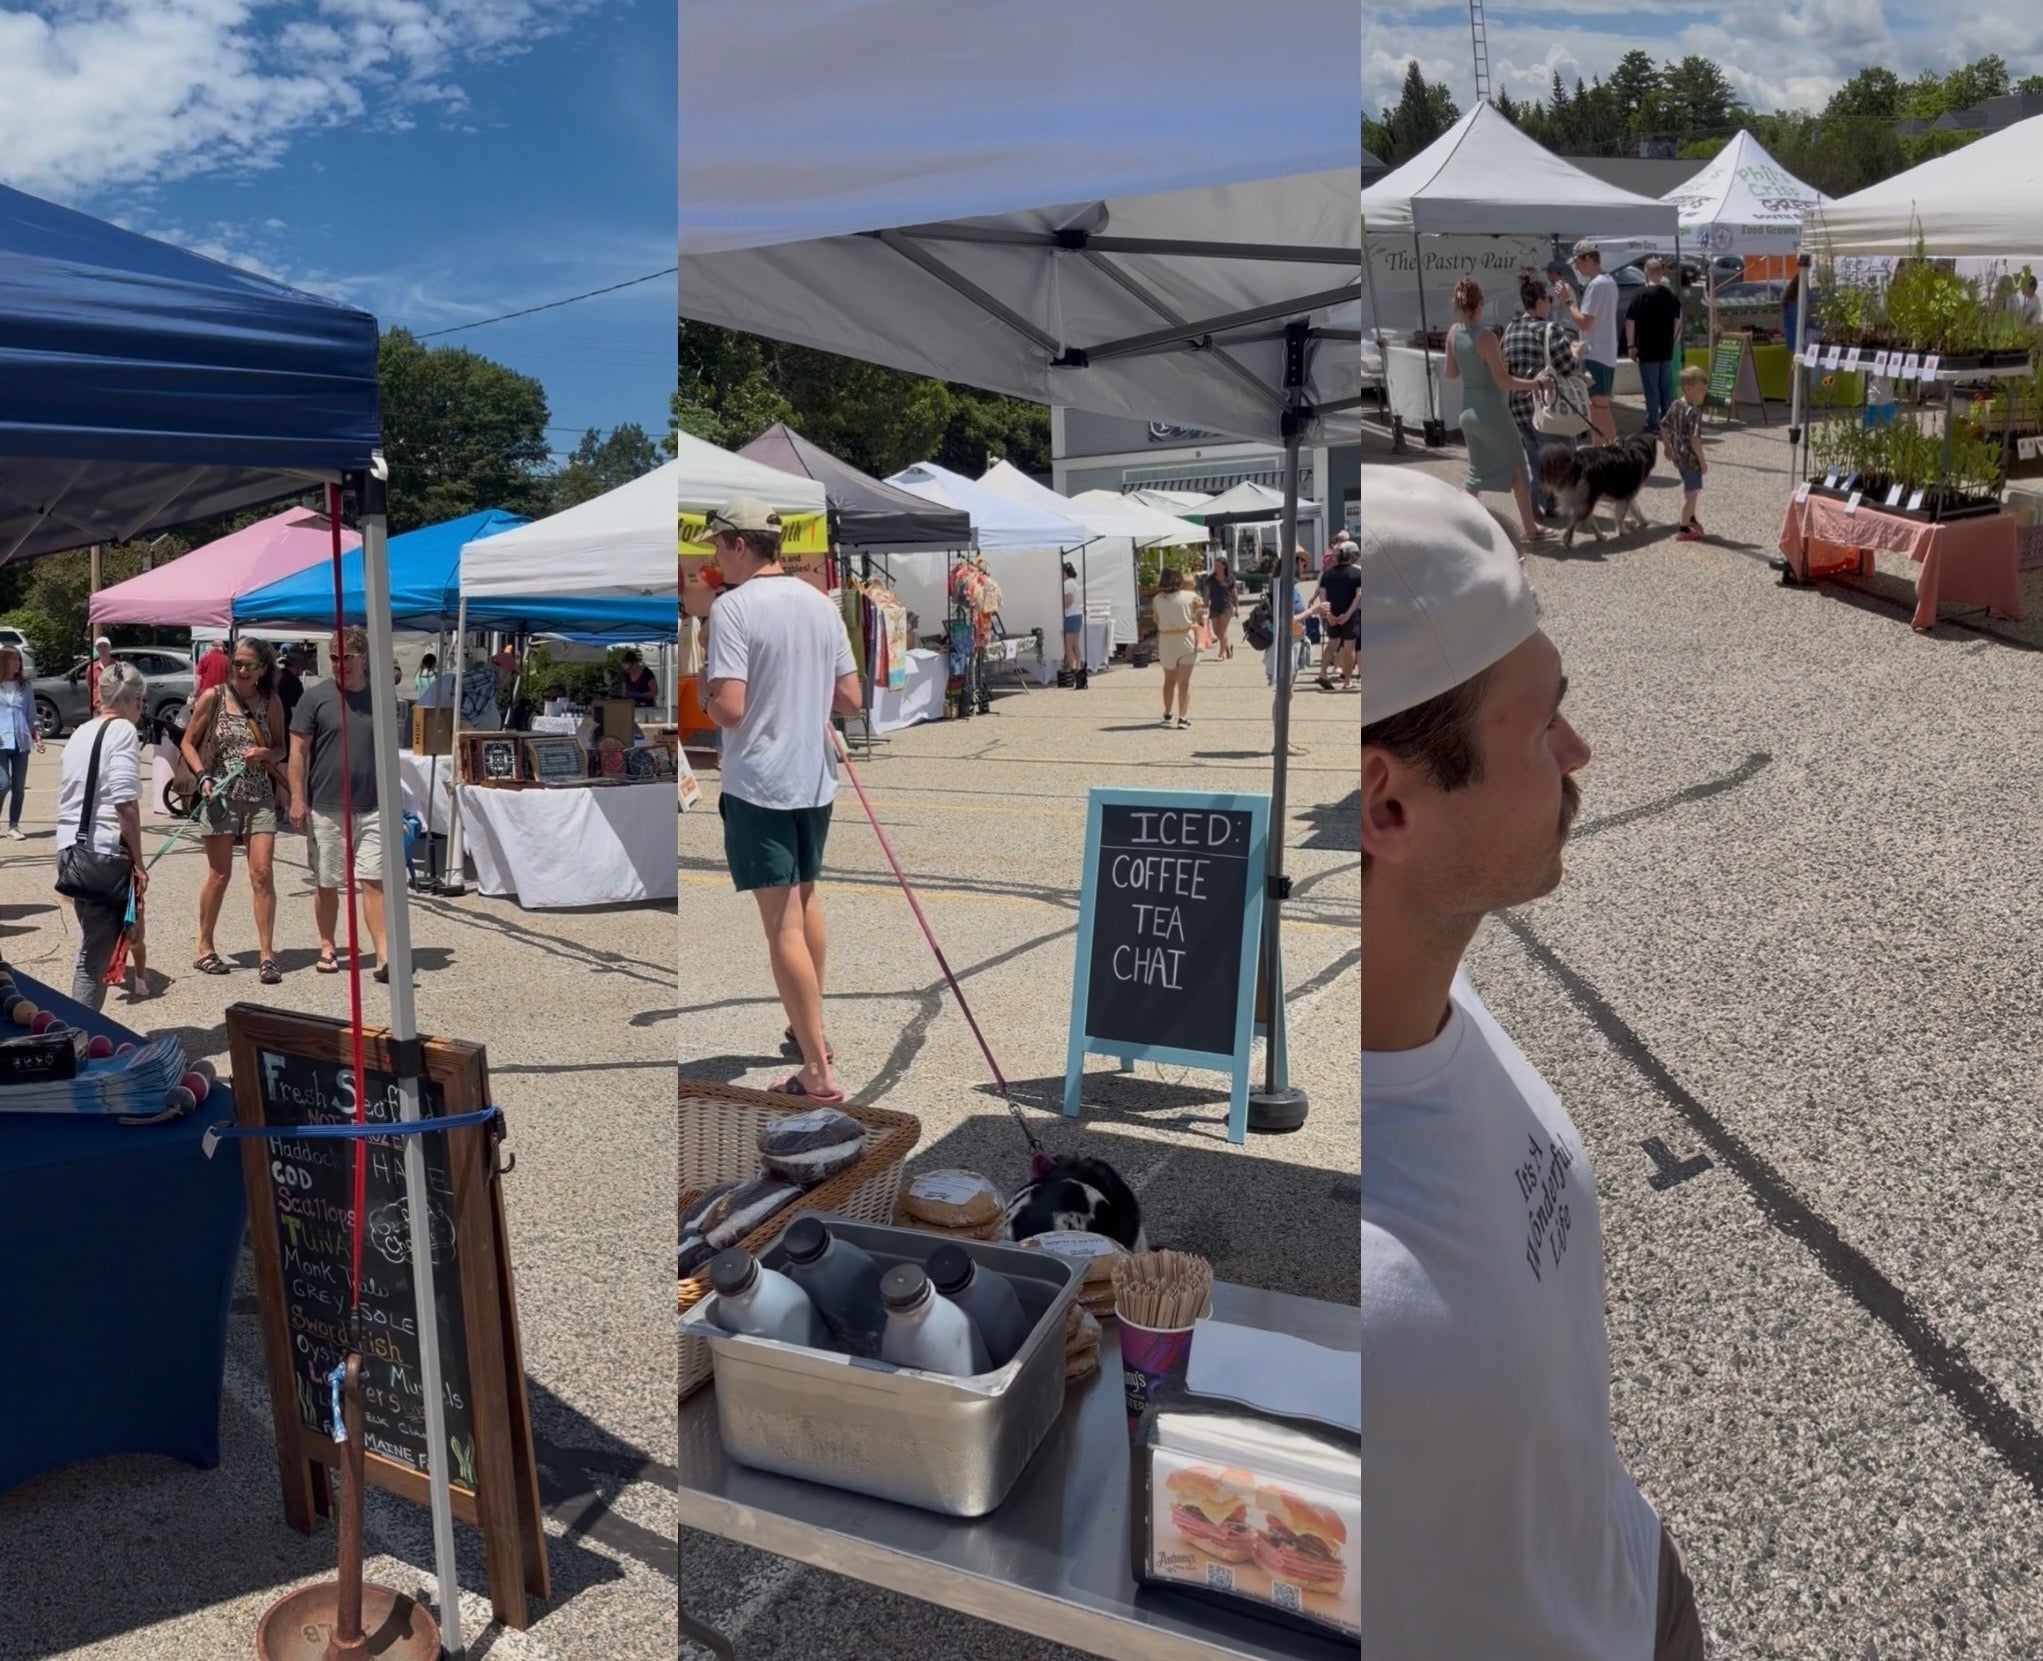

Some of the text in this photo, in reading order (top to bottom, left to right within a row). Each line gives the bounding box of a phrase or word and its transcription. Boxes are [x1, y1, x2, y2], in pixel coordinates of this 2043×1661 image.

[1742, 225, 1764, 234] Food
[1385, 250, 1517, 275] The Pastry Pair
[1130, 812, 1242, 846] ICED:
[1112, 854, 1211, 900] COFFEE
[1132, 904, 1185, 943] TEA
[1113, 945, 1187, 990] CHAI
[262, 1051, 328, 1109] Fresh
[271, 1160, 313, 1189] COD
[373, 1152, 455, 1196] HAE
[1527, 1133, 1574, 1283] Wonderful
[1550, 1204, 1571, 1267] Life
[284, 1244, 337, 1284] Monk
[292, 1279, 417, 1336] GREY SOLE
[364, 1431, 415, 1463] MAINE
